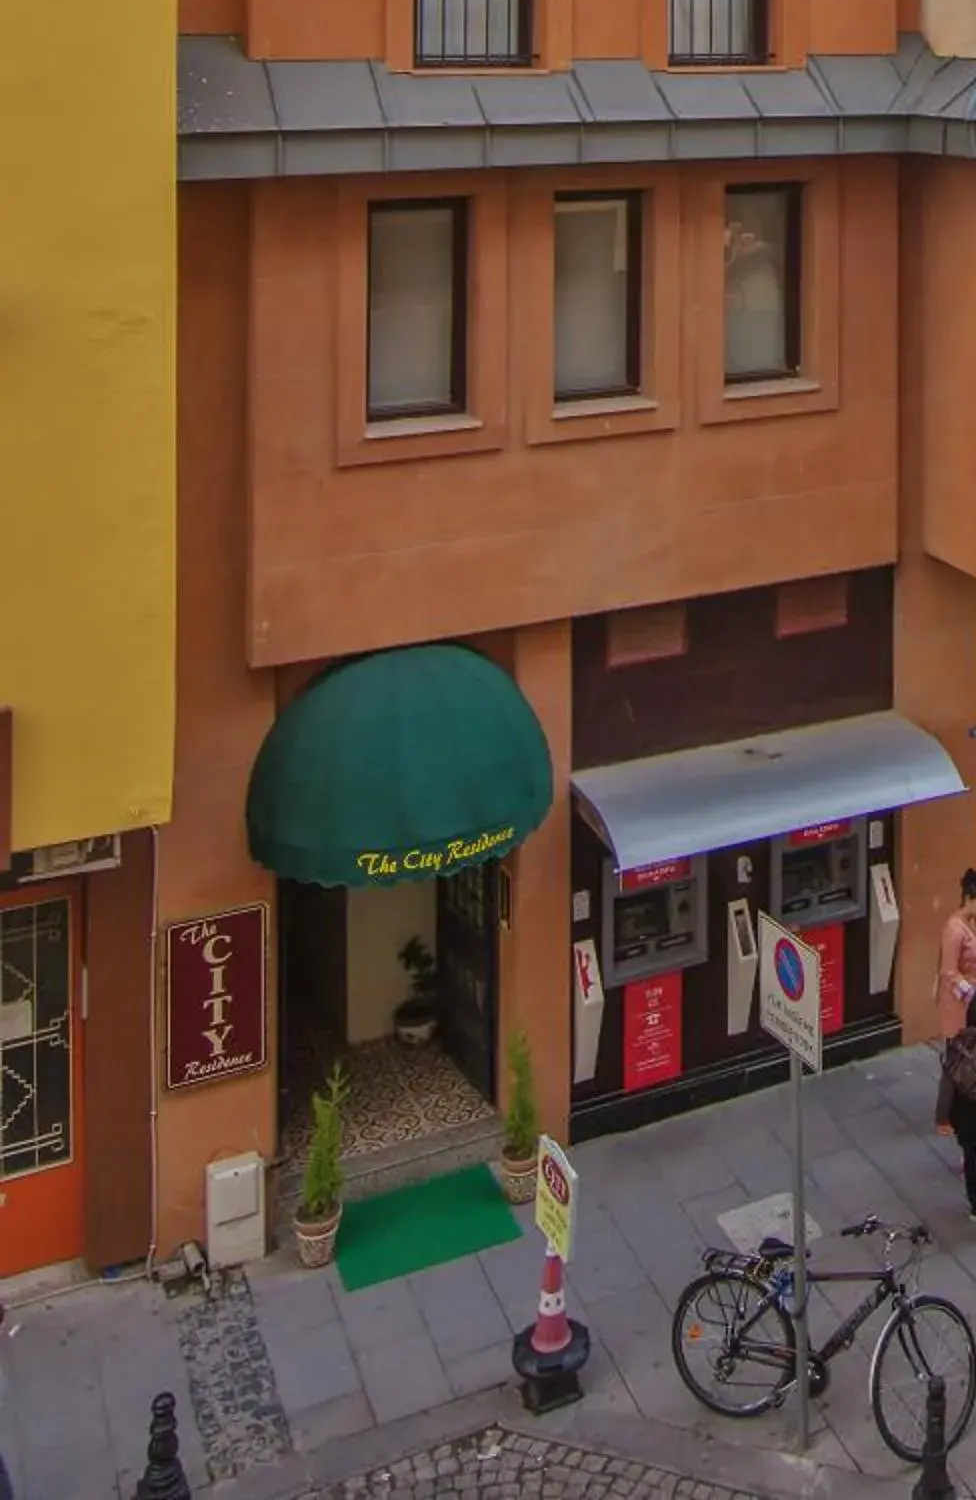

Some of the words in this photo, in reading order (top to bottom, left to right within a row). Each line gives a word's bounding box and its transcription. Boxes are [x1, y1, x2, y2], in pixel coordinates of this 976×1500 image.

[356, 853, 398, 875] The
[403, 850, 443, 870] City
[446, 827, 516, 865] Residence
[179, 920, 218, 945] The
[201, 934, 234, 1057] CITY
[183, 1051, 253, 1081] Residence
